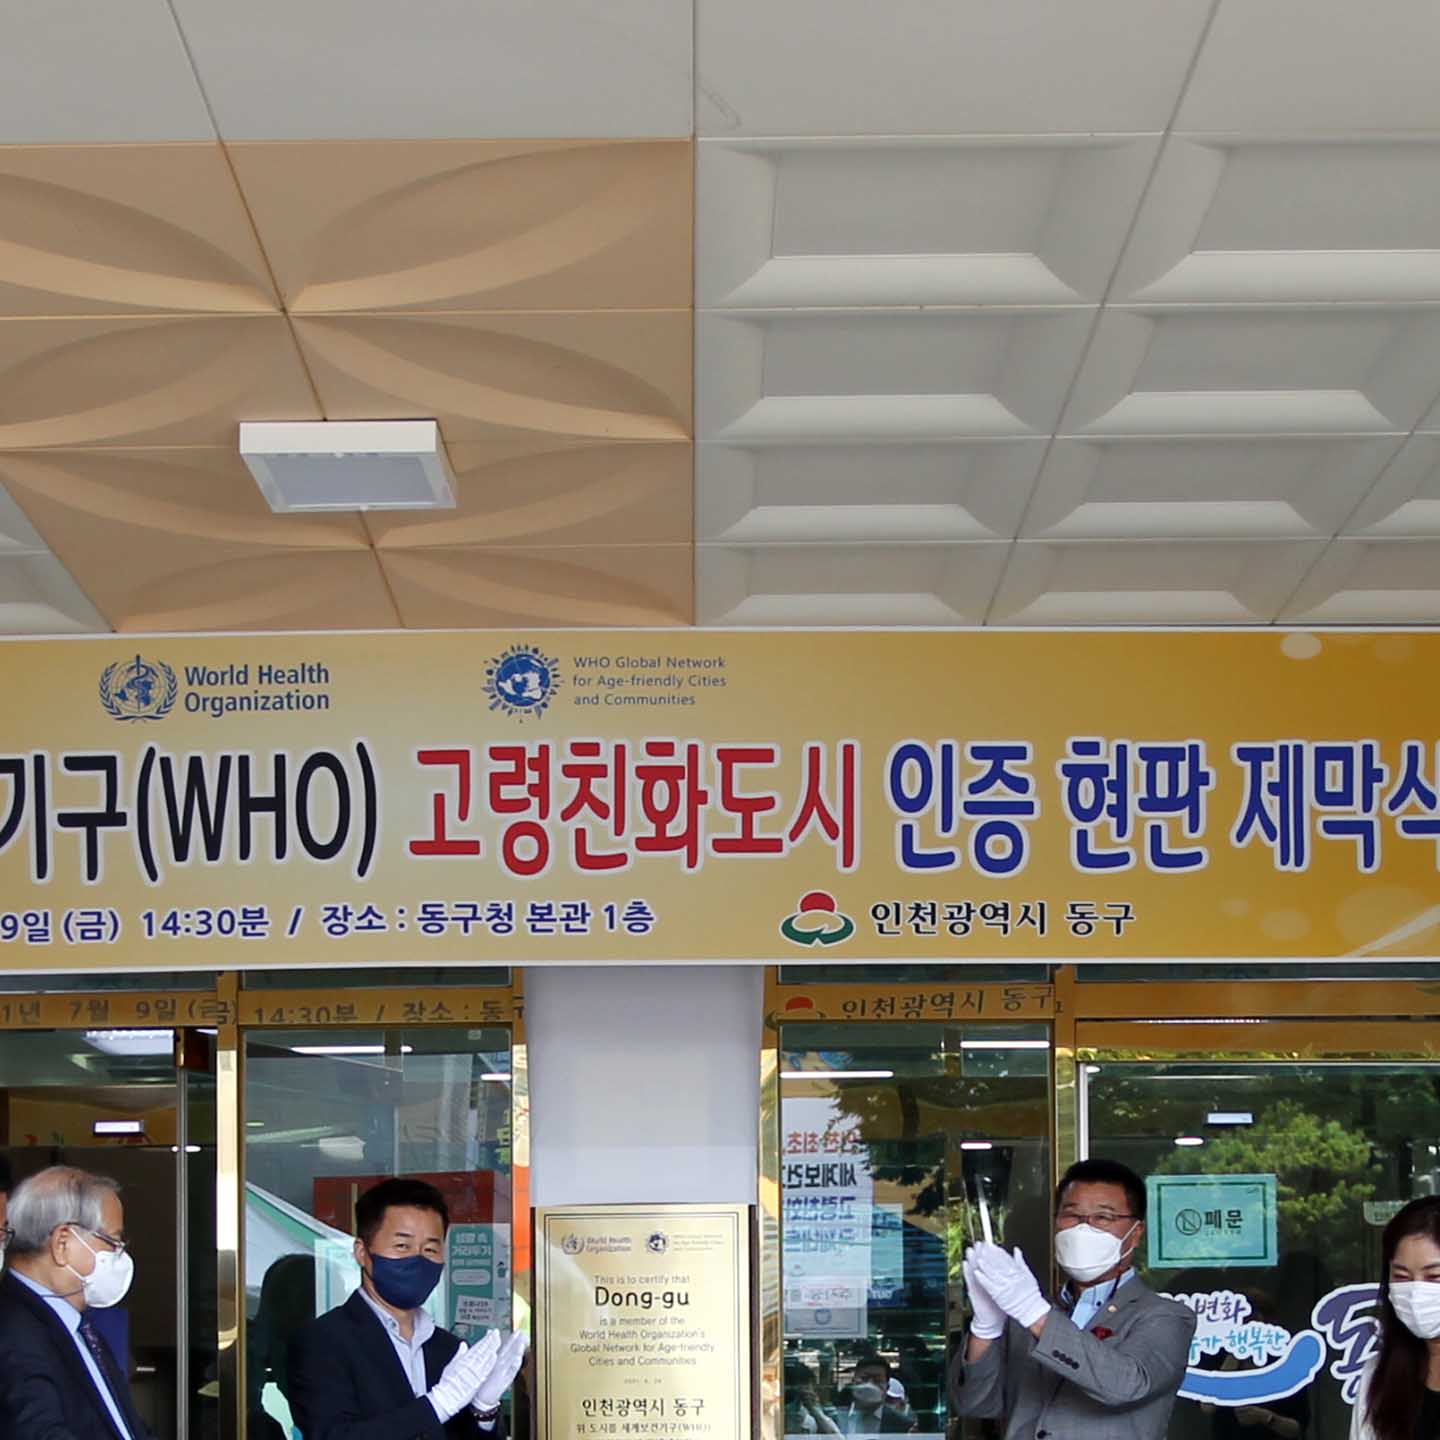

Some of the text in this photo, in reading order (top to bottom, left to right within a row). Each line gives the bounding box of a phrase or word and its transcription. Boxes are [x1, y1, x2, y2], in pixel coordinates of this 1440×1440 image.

[573, 656, 727, 669] WHO Global Network
[184, 664, 330, 688] World Health
[573, 675, 728, 690] for Age-friendly Cities
[184, 690, 330, 714] Organization
[574, 693, 697, 706] and Communities
[408, 742, 856, 876] 고령친화도시
[889, 743, 1035, 874] 인증
[1061, 741, 1211, 870] 현판
[0, 911, 51, 943] 9일
[63, 910, 119, 942] (금)
[141, 907, 270, 938] 14:30분
[416, 902, 515, 935] 동구청
[525, 901, 592, 934] 본관
[602, 902, 656, 935] 1층
[870, 901, 1136, 937] 인천광역시 동구
[594, 1275, 691, 1287] This is to certify that
[594, 1286, 691, 1309] Dong-gu
[599, 1316, 609, 1326] is
[619, 1316, 657, 1326] member
[658, 1315, 669, 1326] of
[670, 1315, 686, 1326] the
[579, 1329, 607, 1340] World
[608, 1329, 639, 1340] Health
[570, 1342, 716, 1354] Global Network for Age-friendly
[1224, 1327, 1286, 1361] 행복한
[588, 1356, 697, 1367] Cities and Communities
[582, 1397, 706, 1418] 인천광역시 동구
